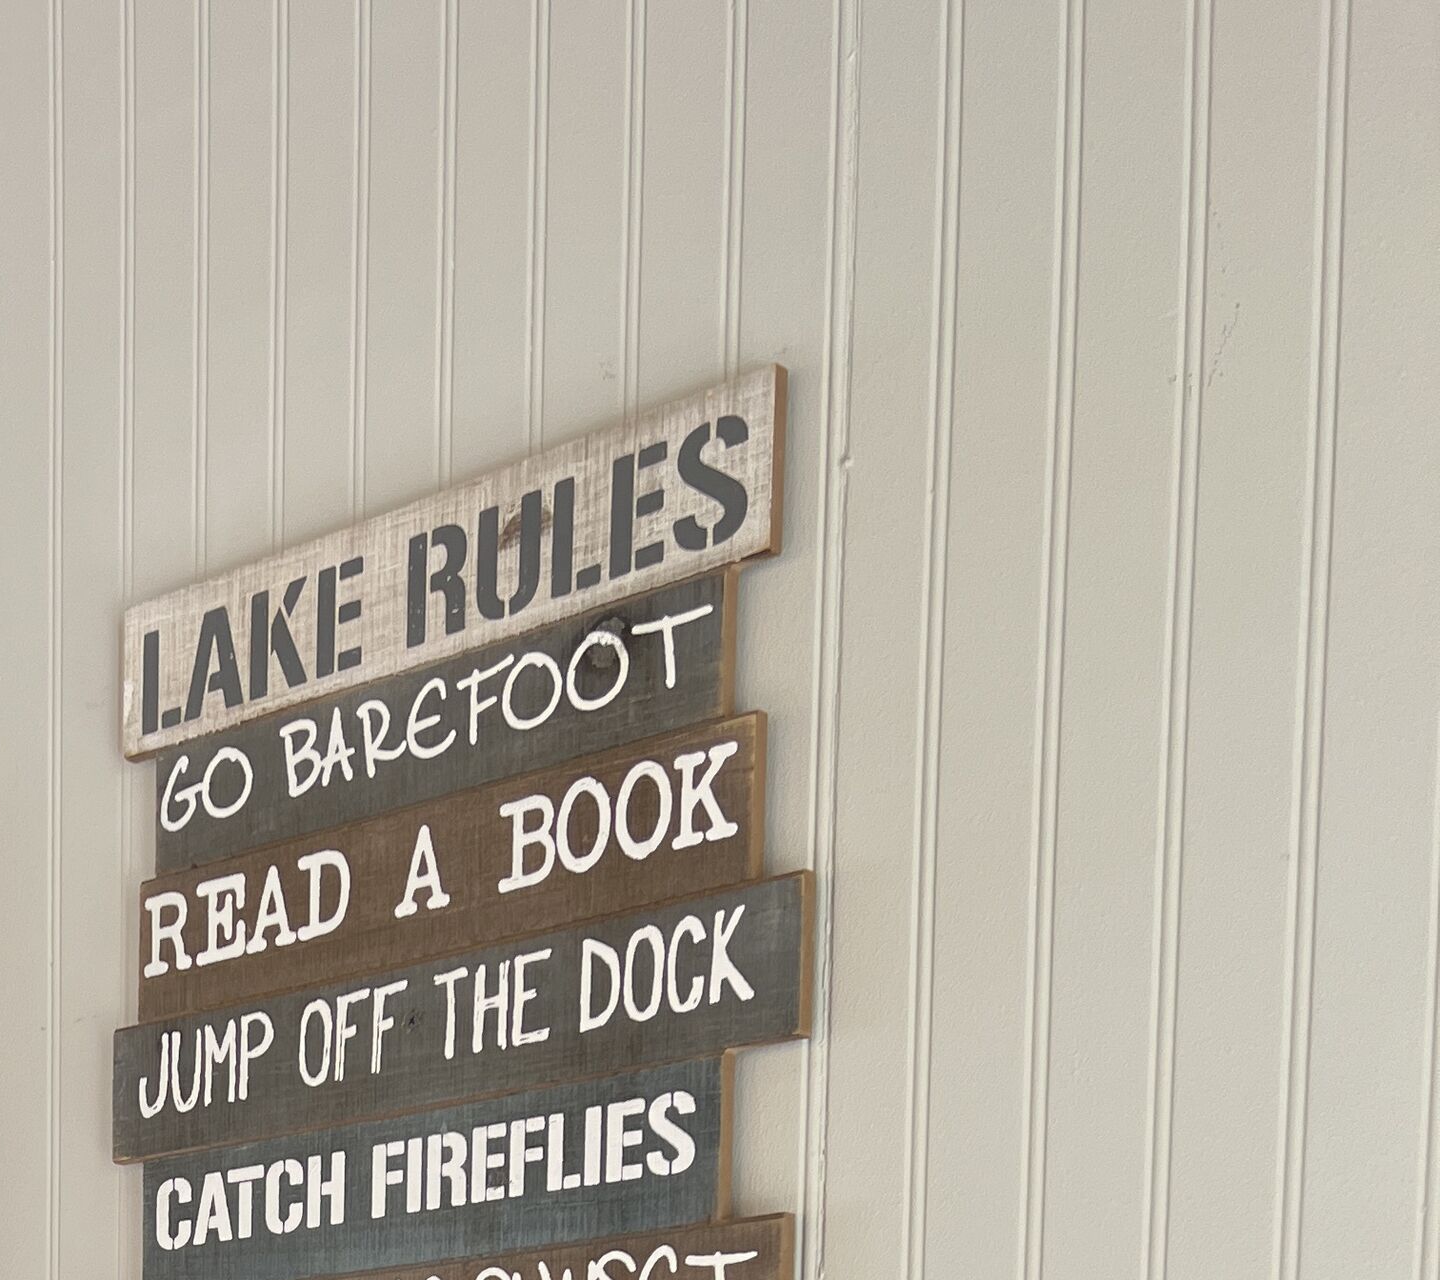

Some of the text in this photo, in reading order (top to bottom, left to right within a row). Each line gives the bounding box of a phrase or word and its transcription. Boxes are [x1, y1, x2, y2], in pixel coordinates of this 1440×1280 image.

[141, 414, 749, 736] LAKE RULES
[160, 604, 714, 832] GO BAREFOOT
[143, 741, 739, 979] READ A BOOK
[139, 904, 756, 1118] JUMP OFF THE DOCK
[154, 1091, 697, 1251] CATCH FIREFLIES
